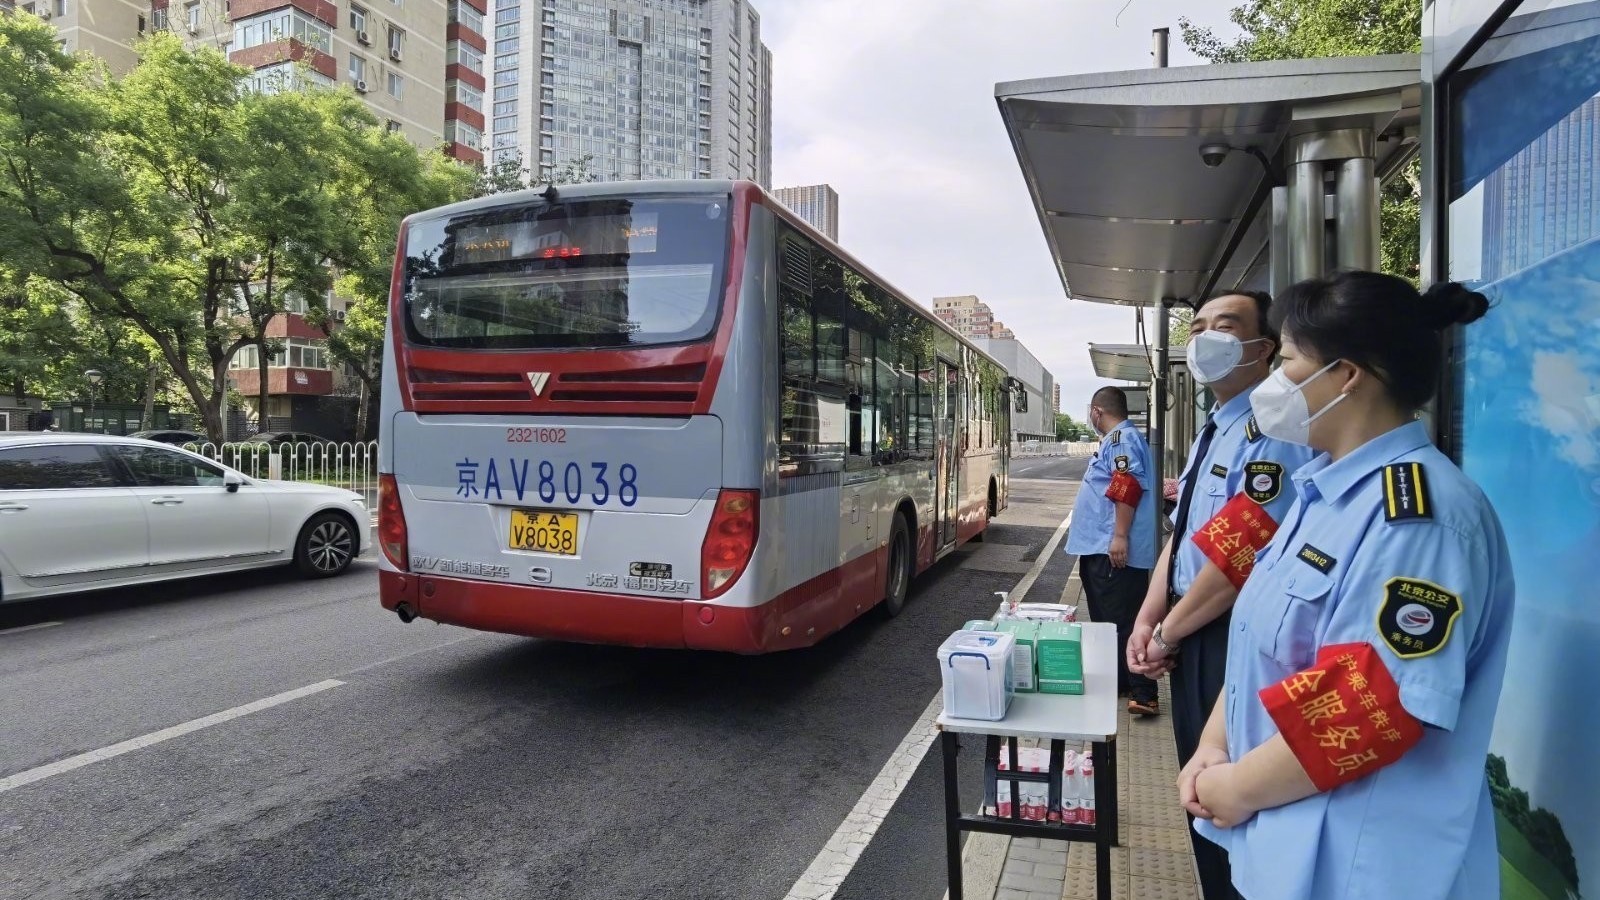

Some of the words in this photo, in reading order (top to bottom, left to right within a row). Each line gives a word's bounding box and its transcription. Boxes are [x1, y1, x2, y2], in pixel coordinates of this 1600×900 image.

[507, 428, 566, 443] 2321602
[456, 457, 638, 507] 京AV8038
[514, 526, 573, 550] V8038
[1201, 516, 1256, 577] 安全服
[1400, 582, 1450, 605] 北京公交
[1391, 631, 1424, 650] 乘务员
[1337, 653, 1402, 742] 护乘车秩序
[1281, 669, 1379, 776] 全服务员
